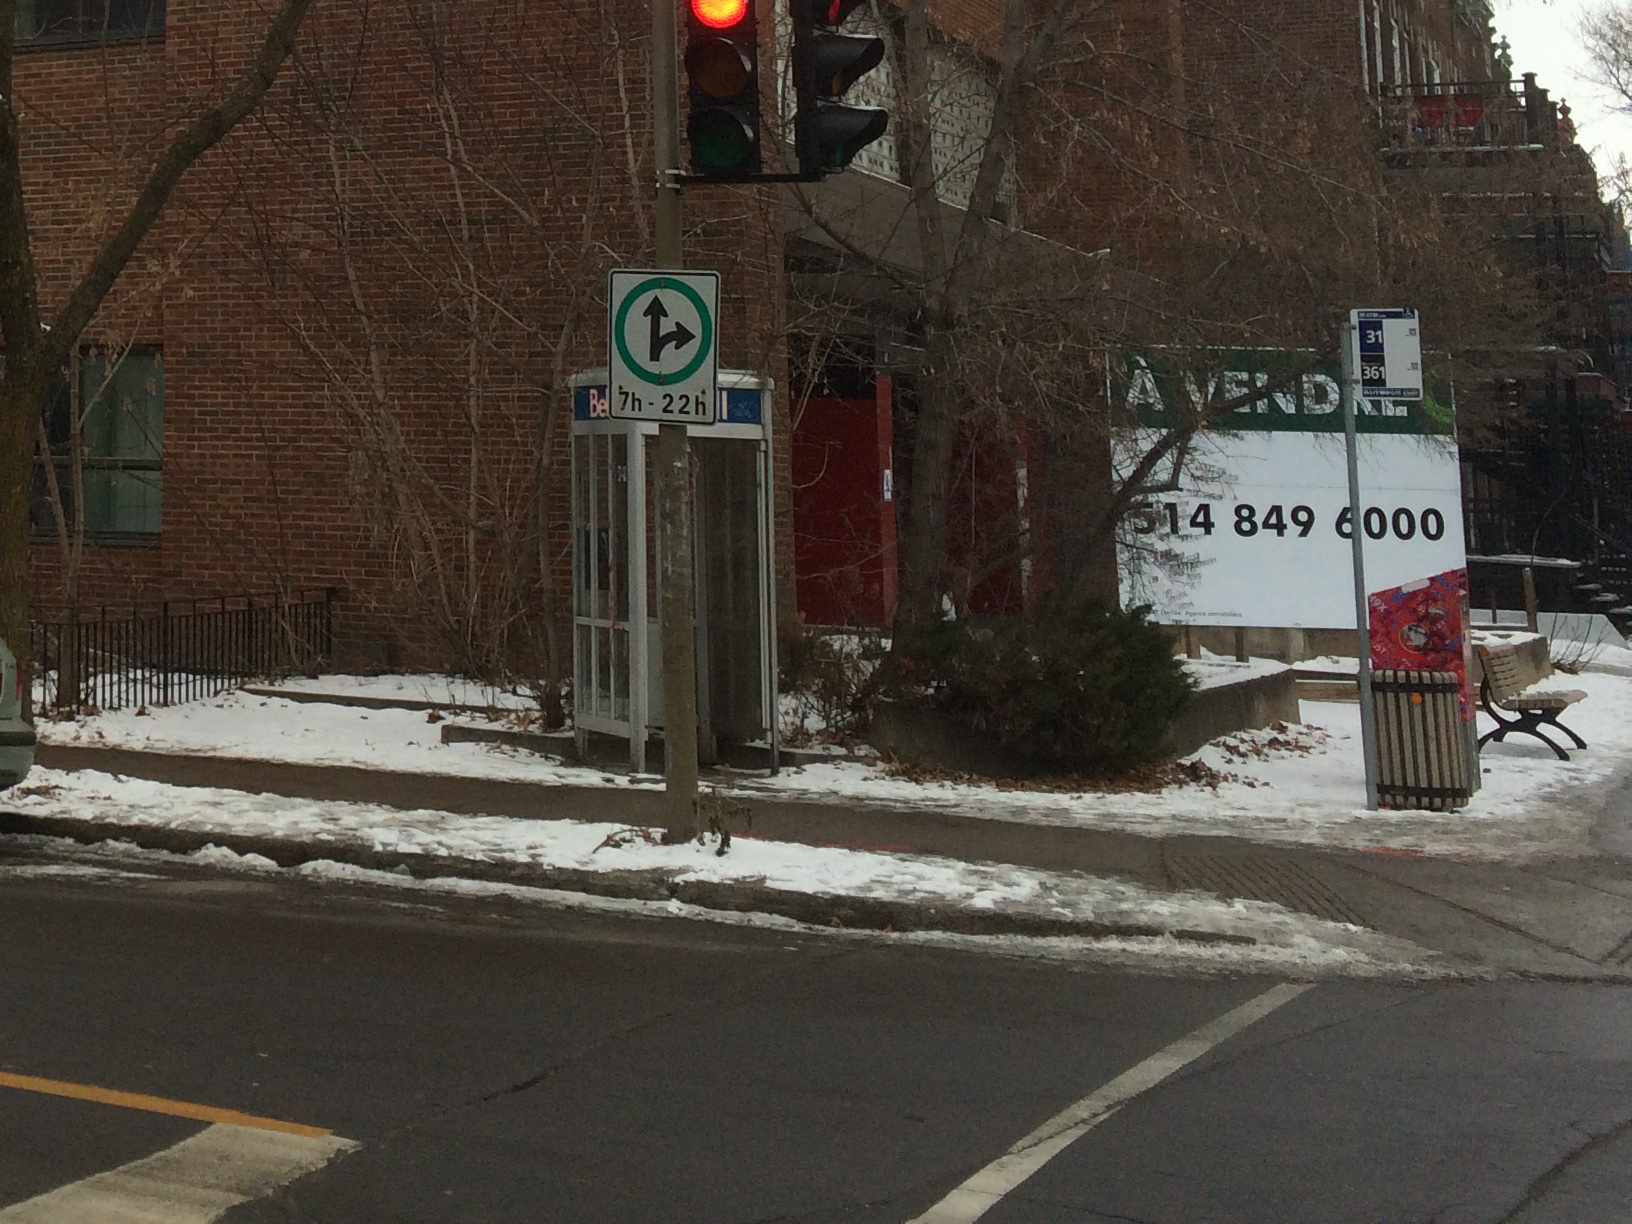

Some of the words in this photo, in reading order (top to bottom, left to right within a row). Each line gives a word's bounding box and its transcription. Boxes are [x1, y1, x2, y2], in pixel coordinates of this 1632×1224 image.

[1366, 329, 1383, 344] 31
[1362, 365, 1386, 380] 361
[618, 391, 642, 413] 7h
[661, 393, 707, 416] 22h
[1233, 503, 1316, 538] 849
[1334, 507, 1445, 541] 6000
